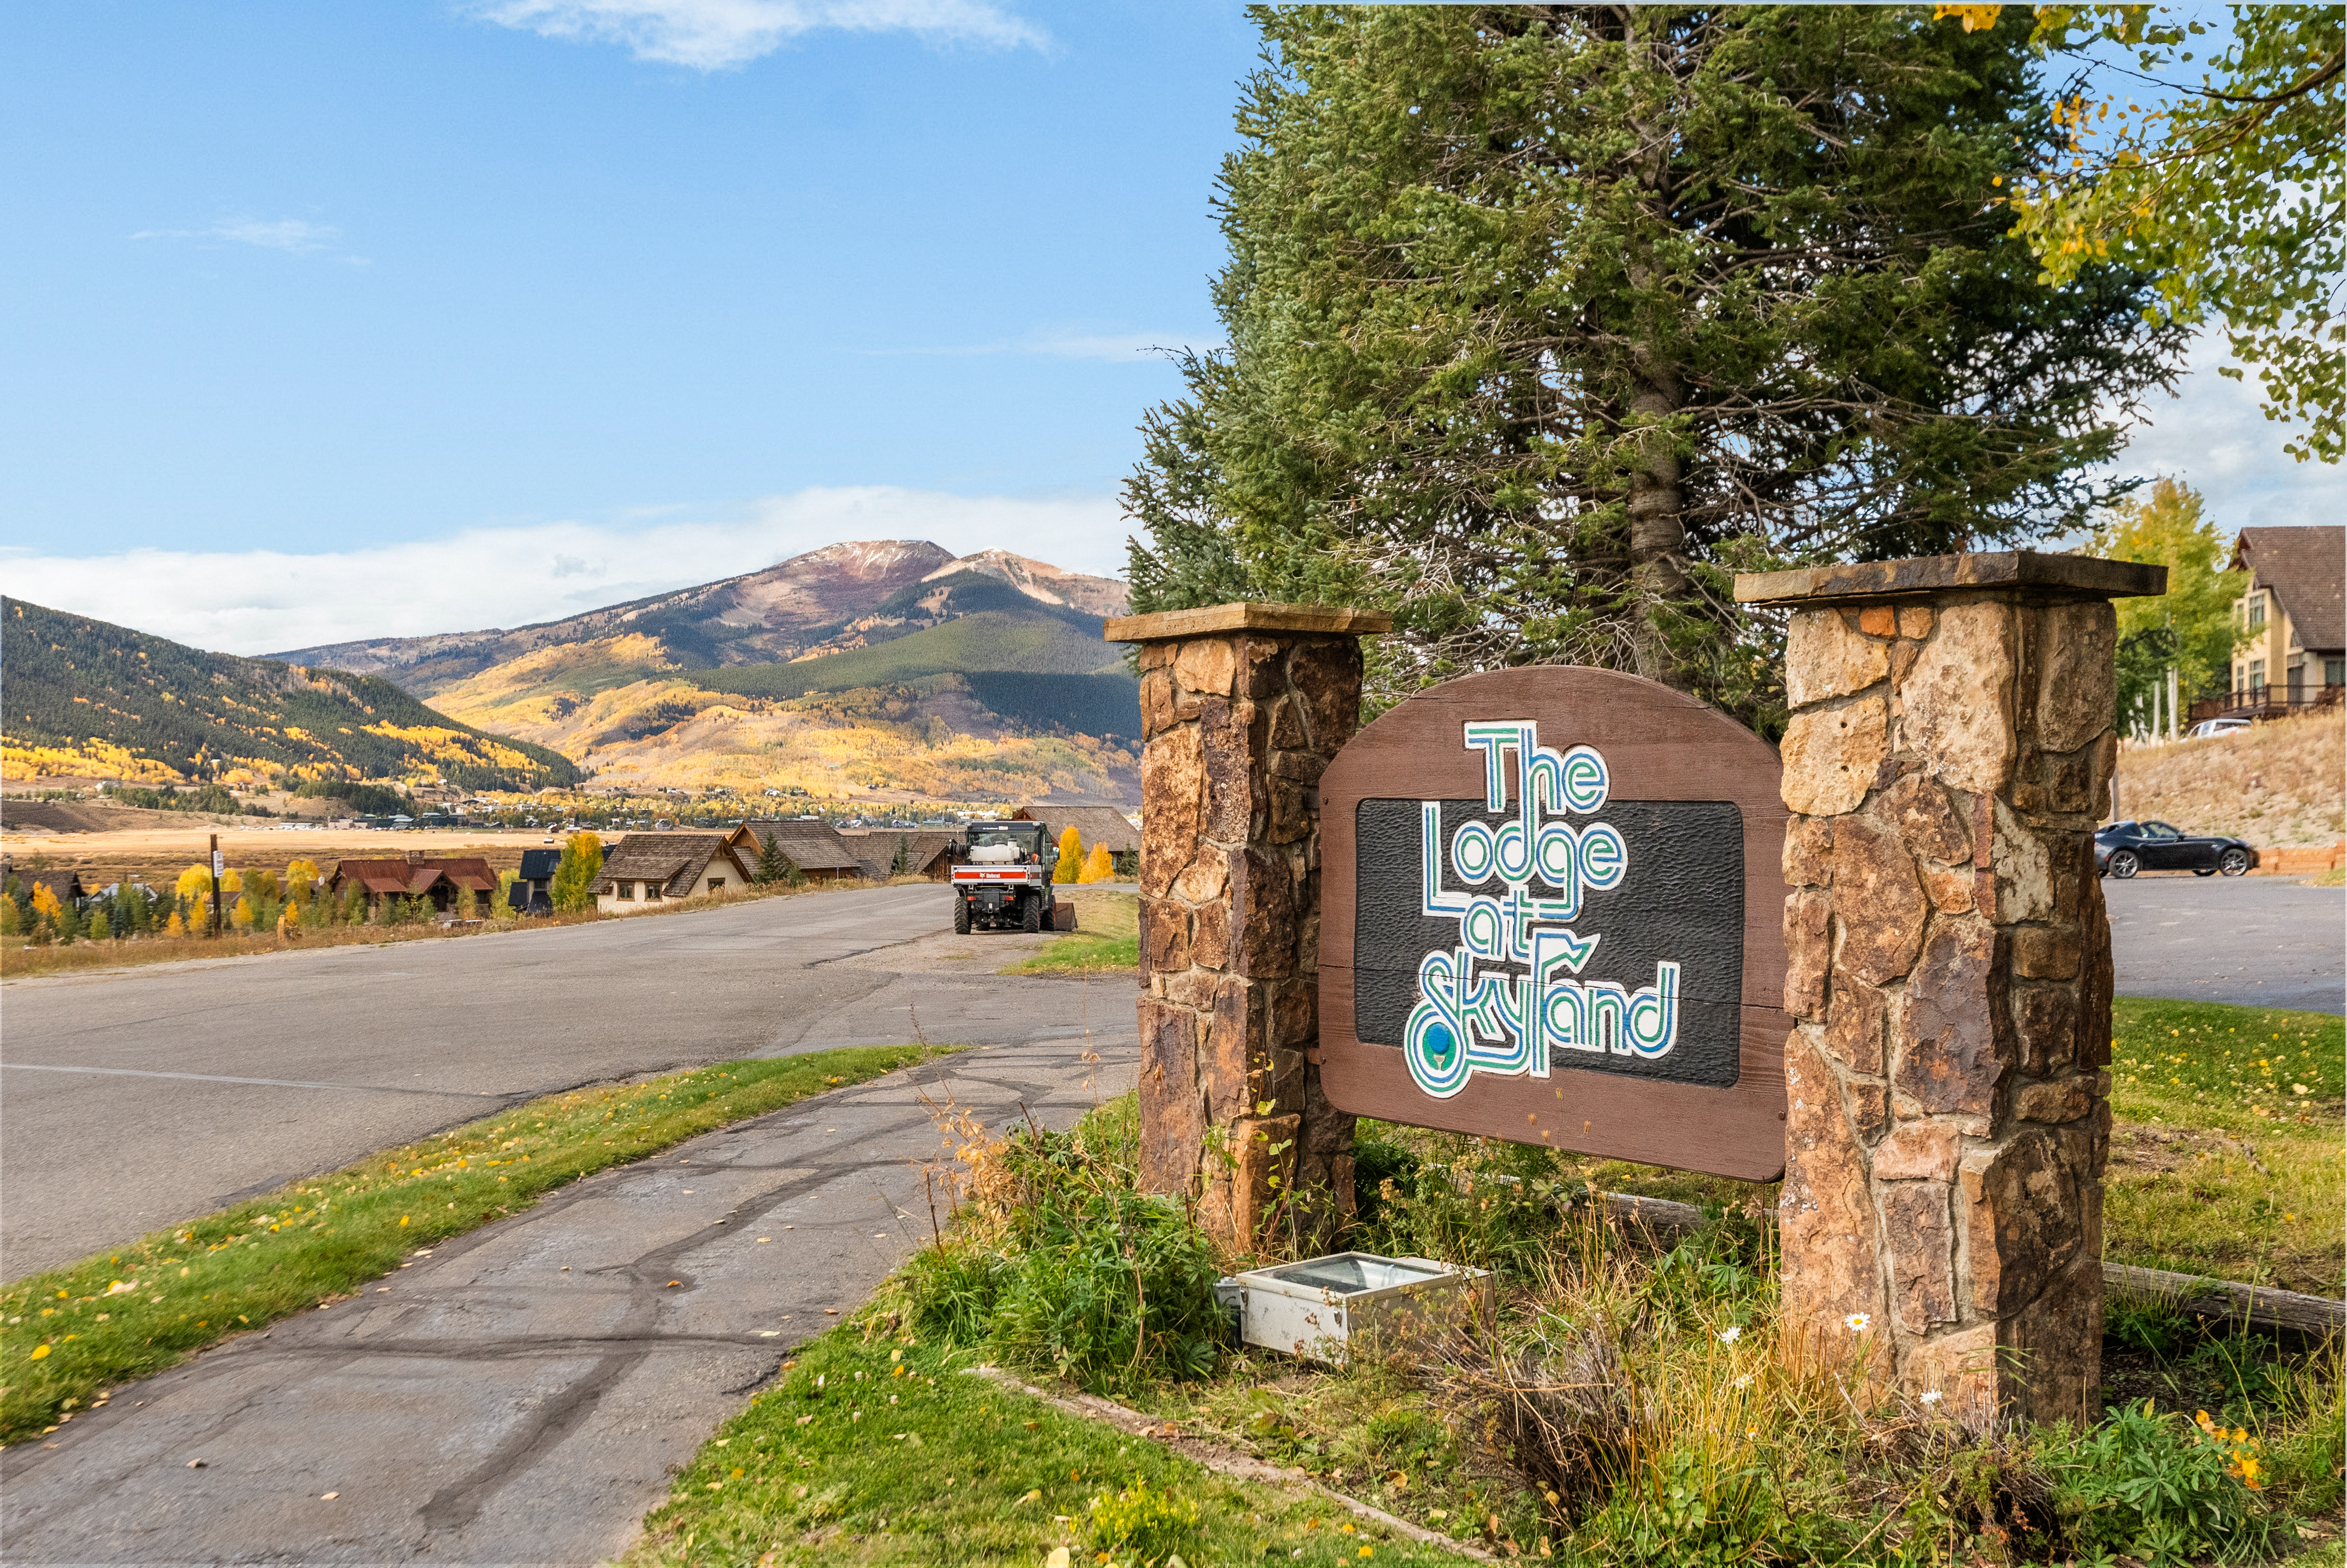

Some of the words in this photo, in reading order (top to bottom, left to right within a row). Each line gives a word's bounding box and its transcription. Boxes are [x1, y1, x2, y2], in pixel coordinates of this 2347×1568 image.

[1463, 721, 1609, 814] The
[1422, 801, 1628, 923] Lodge
[1460, 884, 1531, 963] at
[1403, 928, 1681, 1099] Skyland
